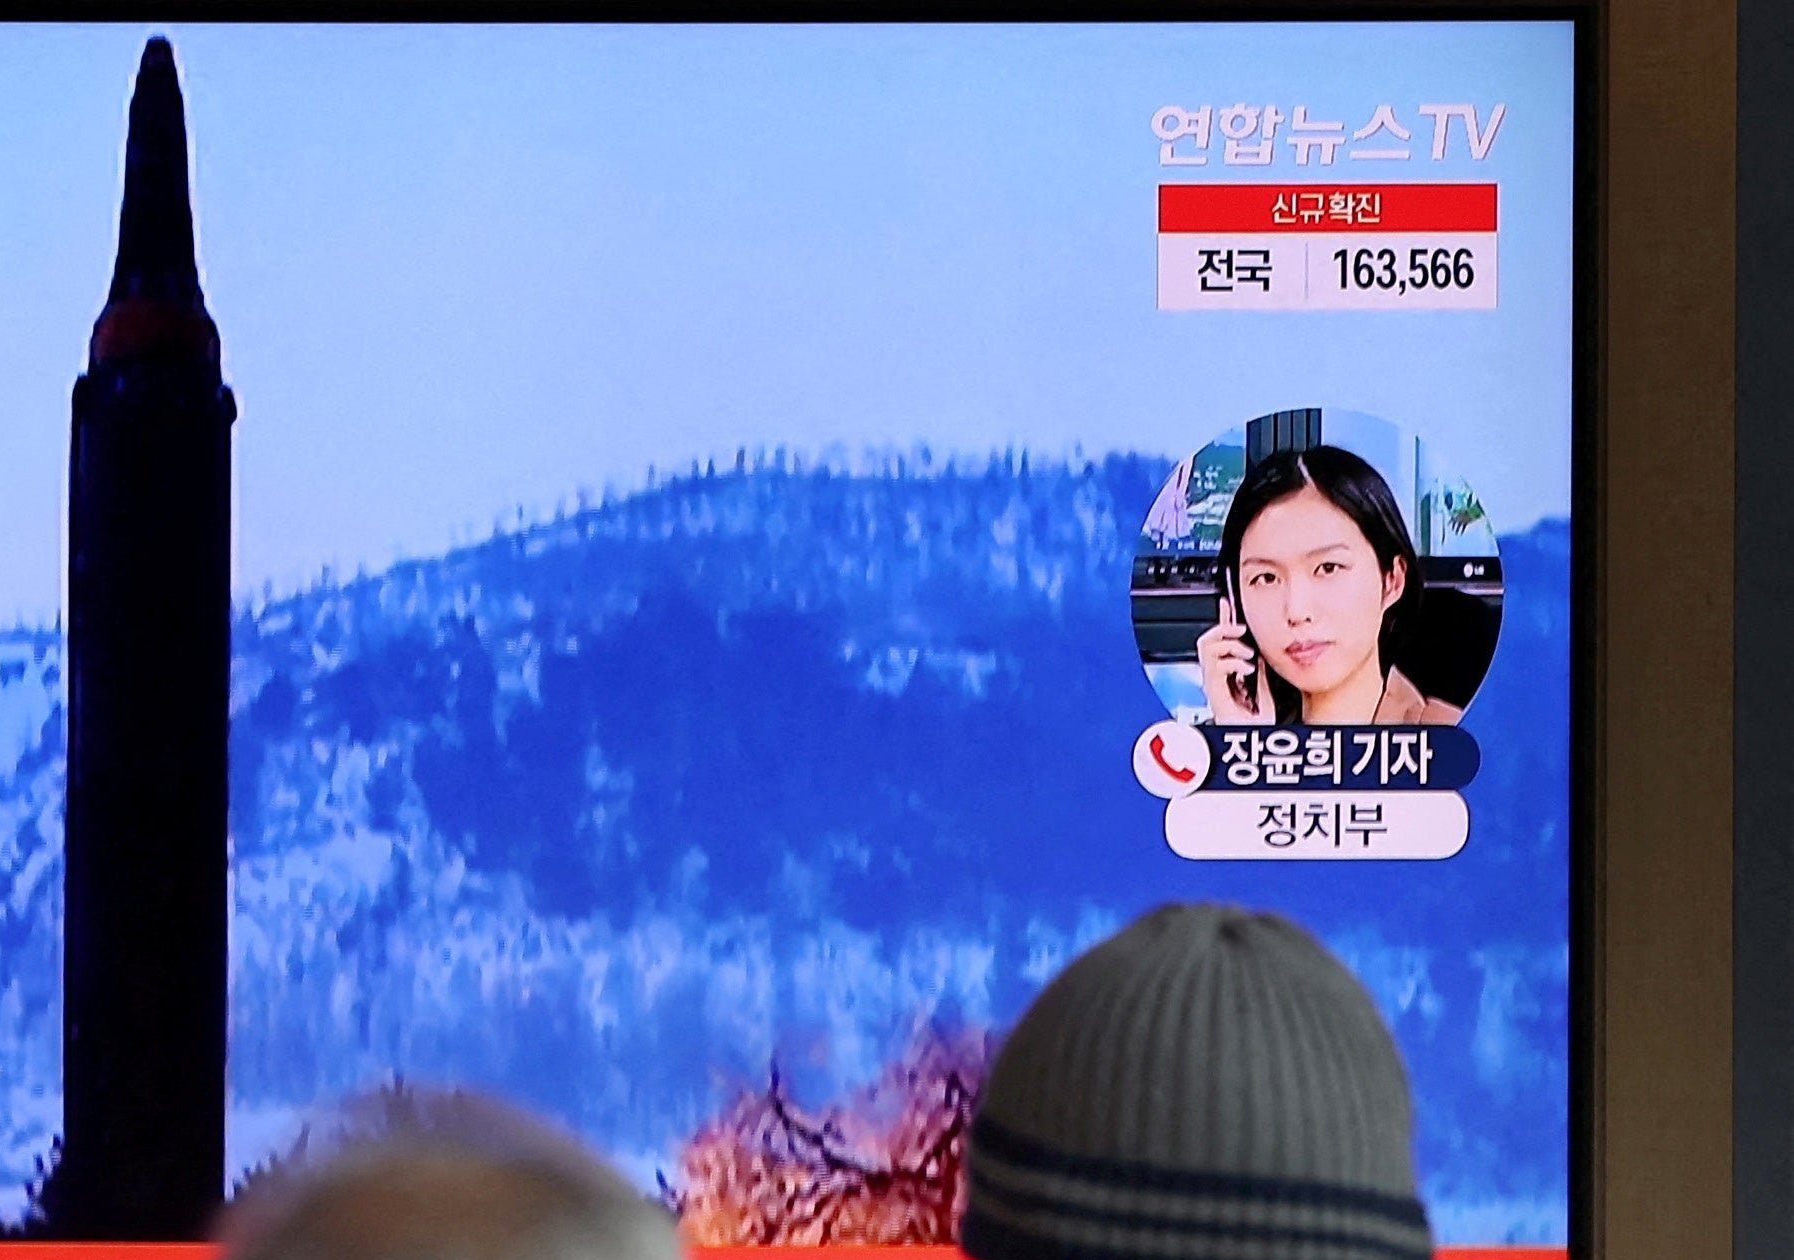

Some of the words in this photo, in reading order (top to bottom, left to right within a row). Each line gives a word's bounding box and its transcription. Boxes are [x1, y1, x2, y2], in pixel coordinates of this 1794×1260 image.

[1197, 248, 1273, 292] 전국
[1333, 248, 1475, 296] 163,566
[1220, 729, 1343, 786] 장윤희
[1351, 729, 1434, 786] 기자
[1256, 802, 1388, 848] 정치부
